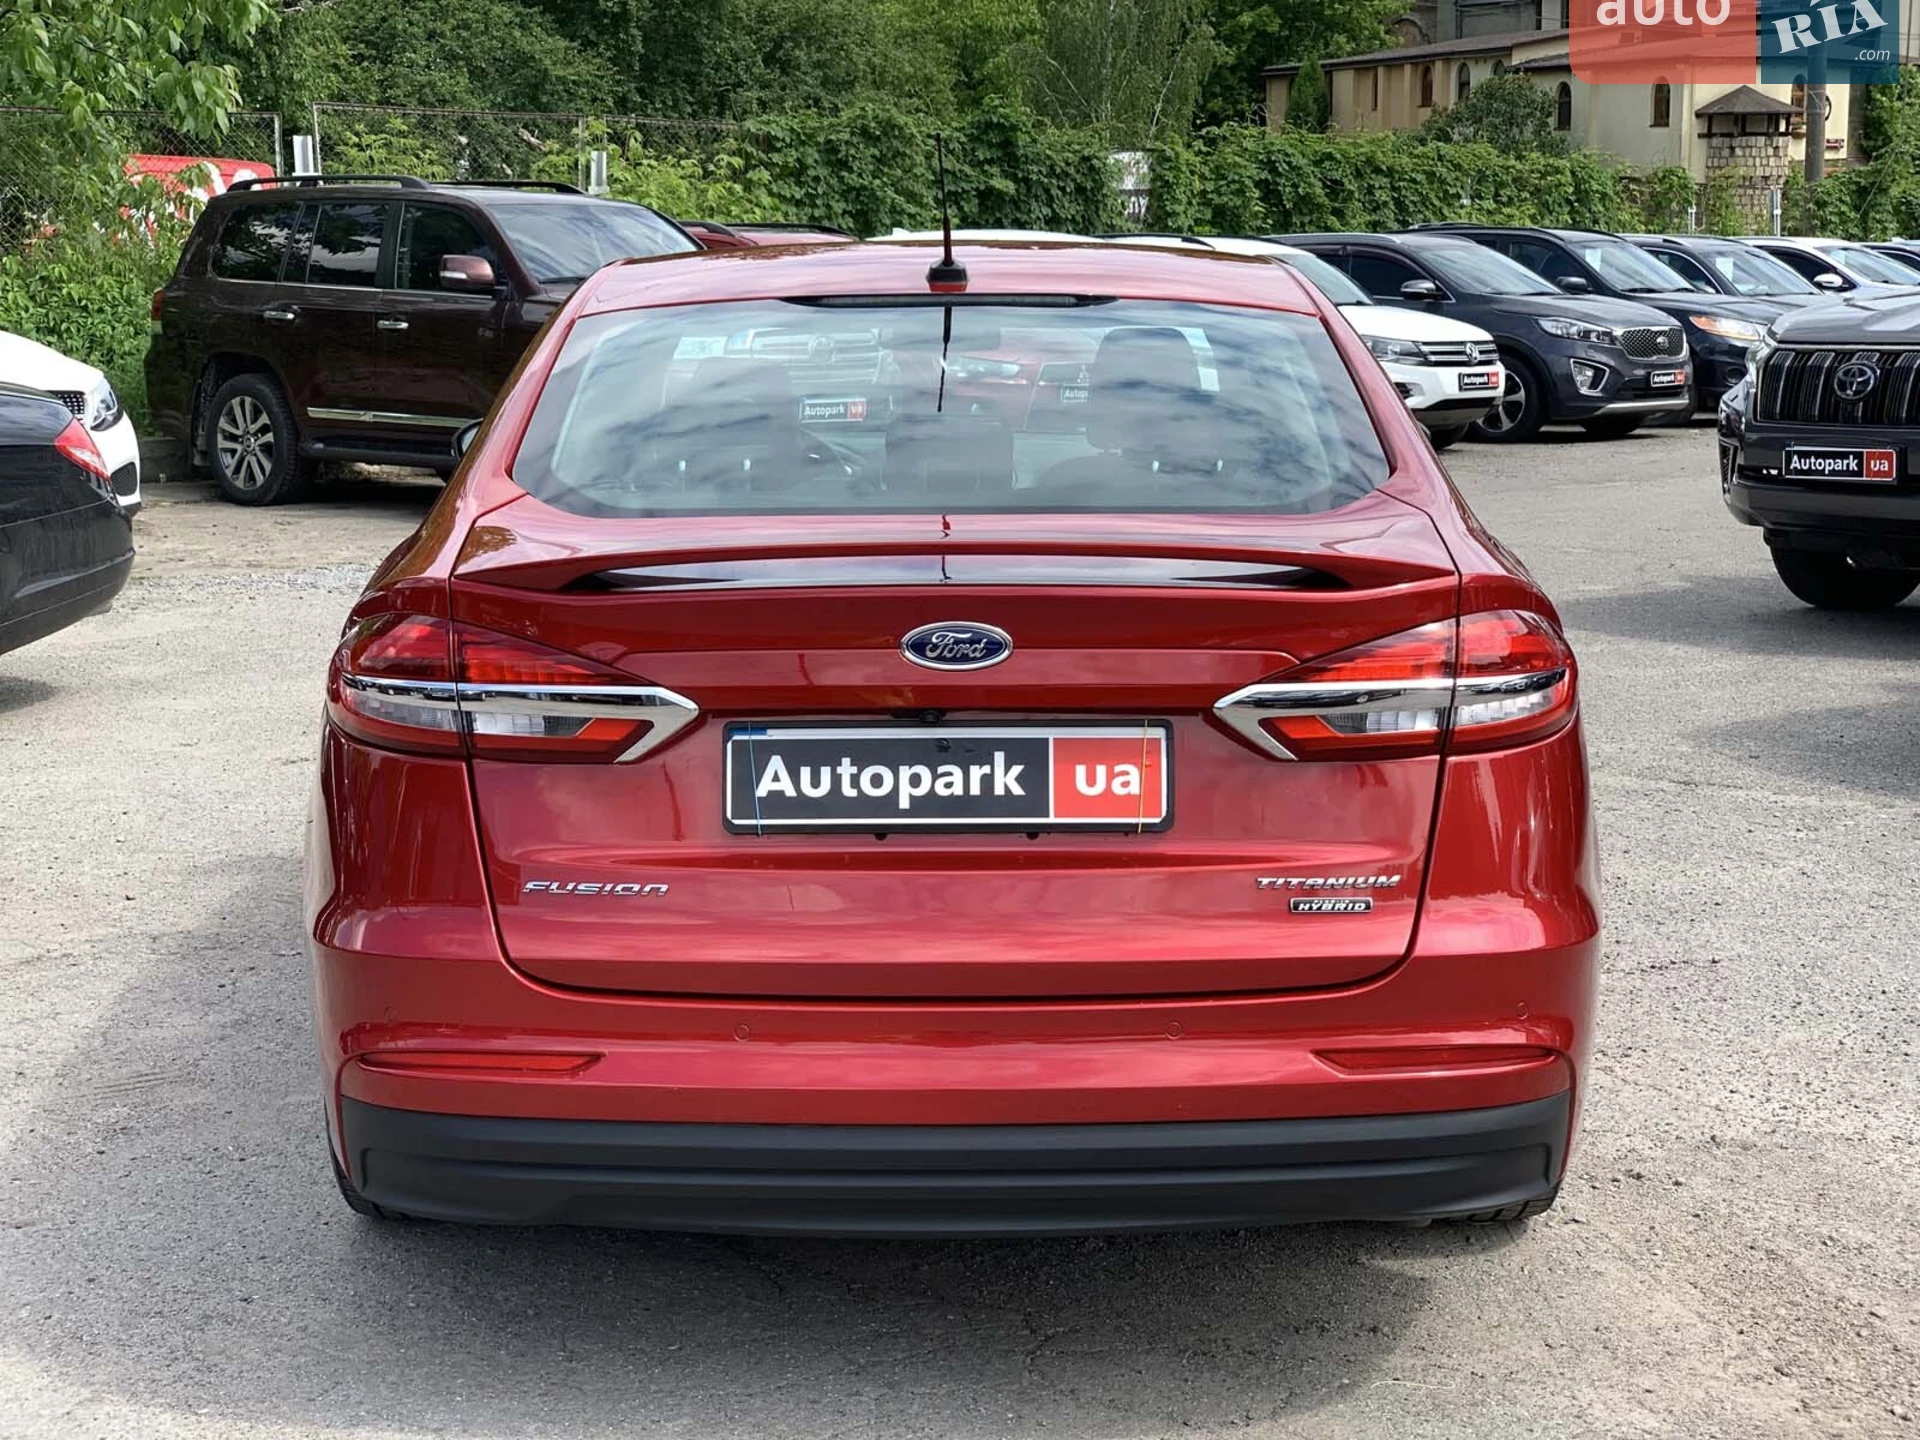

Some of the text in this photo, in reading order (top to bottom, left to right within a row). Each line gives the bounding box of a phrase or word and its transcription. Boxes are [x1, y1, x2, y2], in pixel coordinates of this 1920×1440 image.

[803, 403, 846, 419] Autopark
[1789, 454, 1889, 475] Autopark ua
[925, 631, 988, 659] Ford
[755, 751, 1141, 810] Autopark ua
[522, 881, 670, 896] FUSION
[1256, 874, 1402, 890] TITANIUM
[1298, 902, 1367, 911] HYBRID
